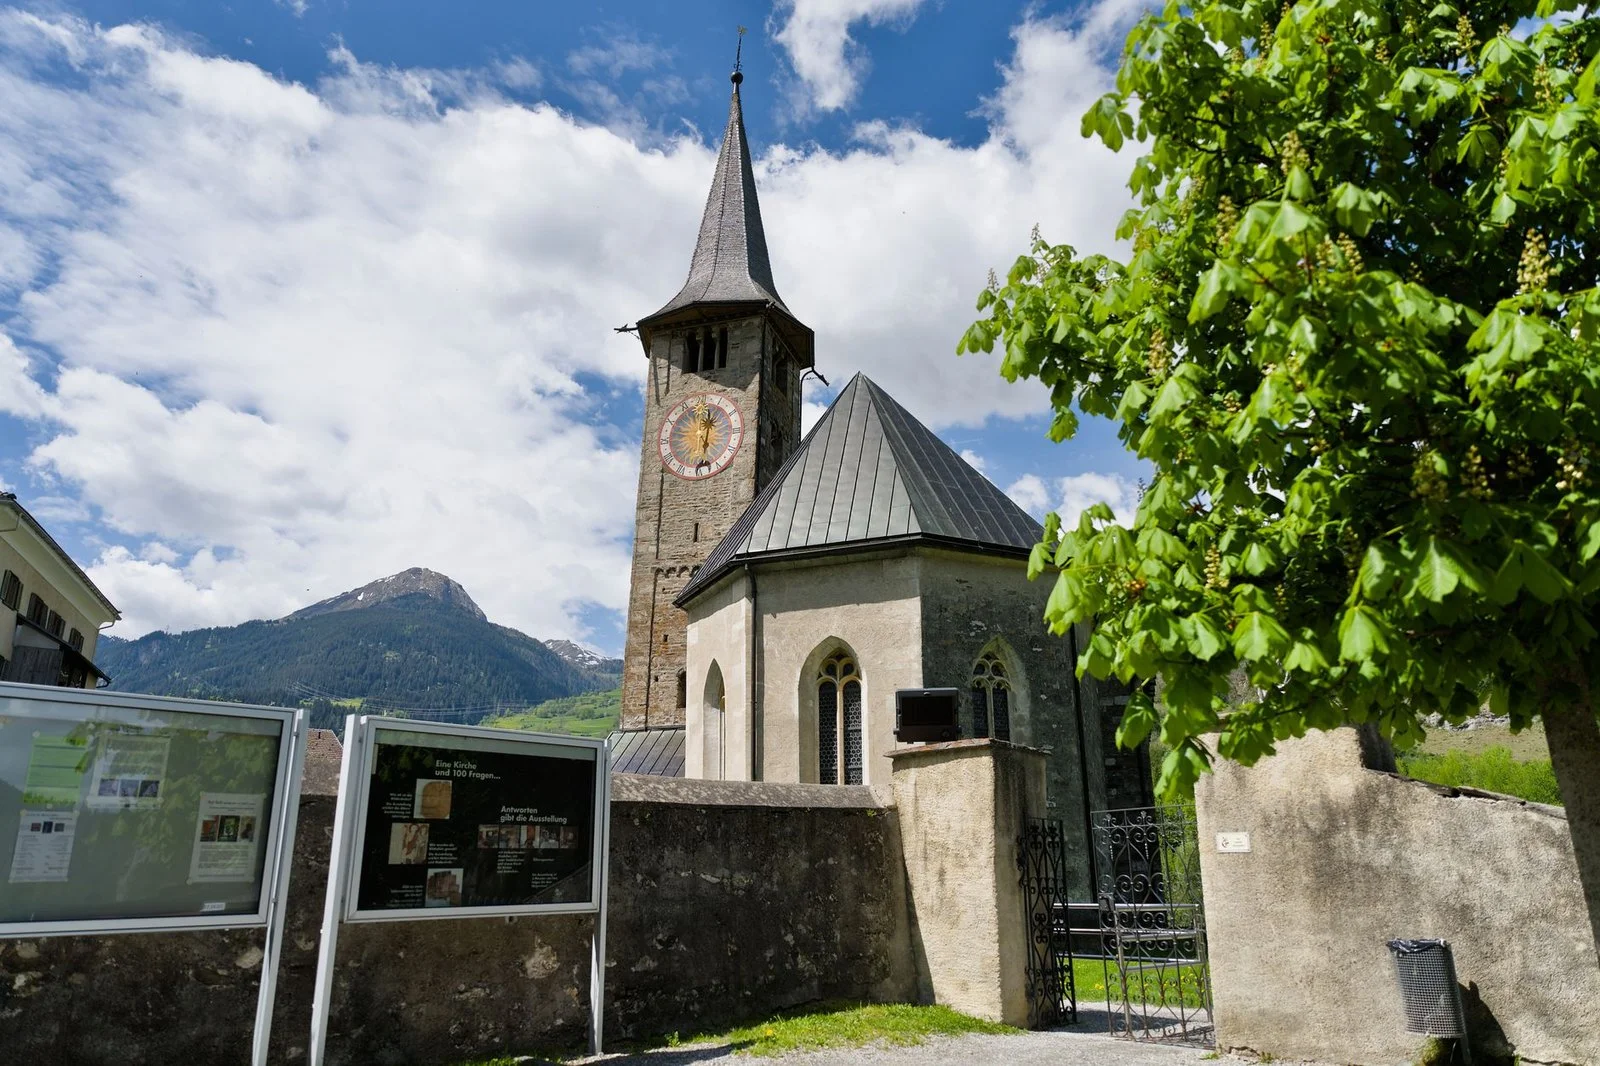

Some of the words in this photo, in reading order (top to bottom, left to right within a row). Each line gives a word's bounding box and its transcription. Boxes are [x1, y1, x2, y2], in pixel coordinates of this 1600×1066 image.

[681, 402, 689, 411] XI
[728, 408, 737, 416] II
[435, 759, 452, 768] Eine
[454, 760, 478, 770] Kirche
[435, 768, 450, 776] und
[452, 769, 468, 778] 100
[468, 770, 501, 780] Fragen...
[500, 805, 538, 814] Antworten
[500, 813, 514, 824] gibt
[516, 814, 528, 822] die
[528, 814, 568, 824] Ausstellung
